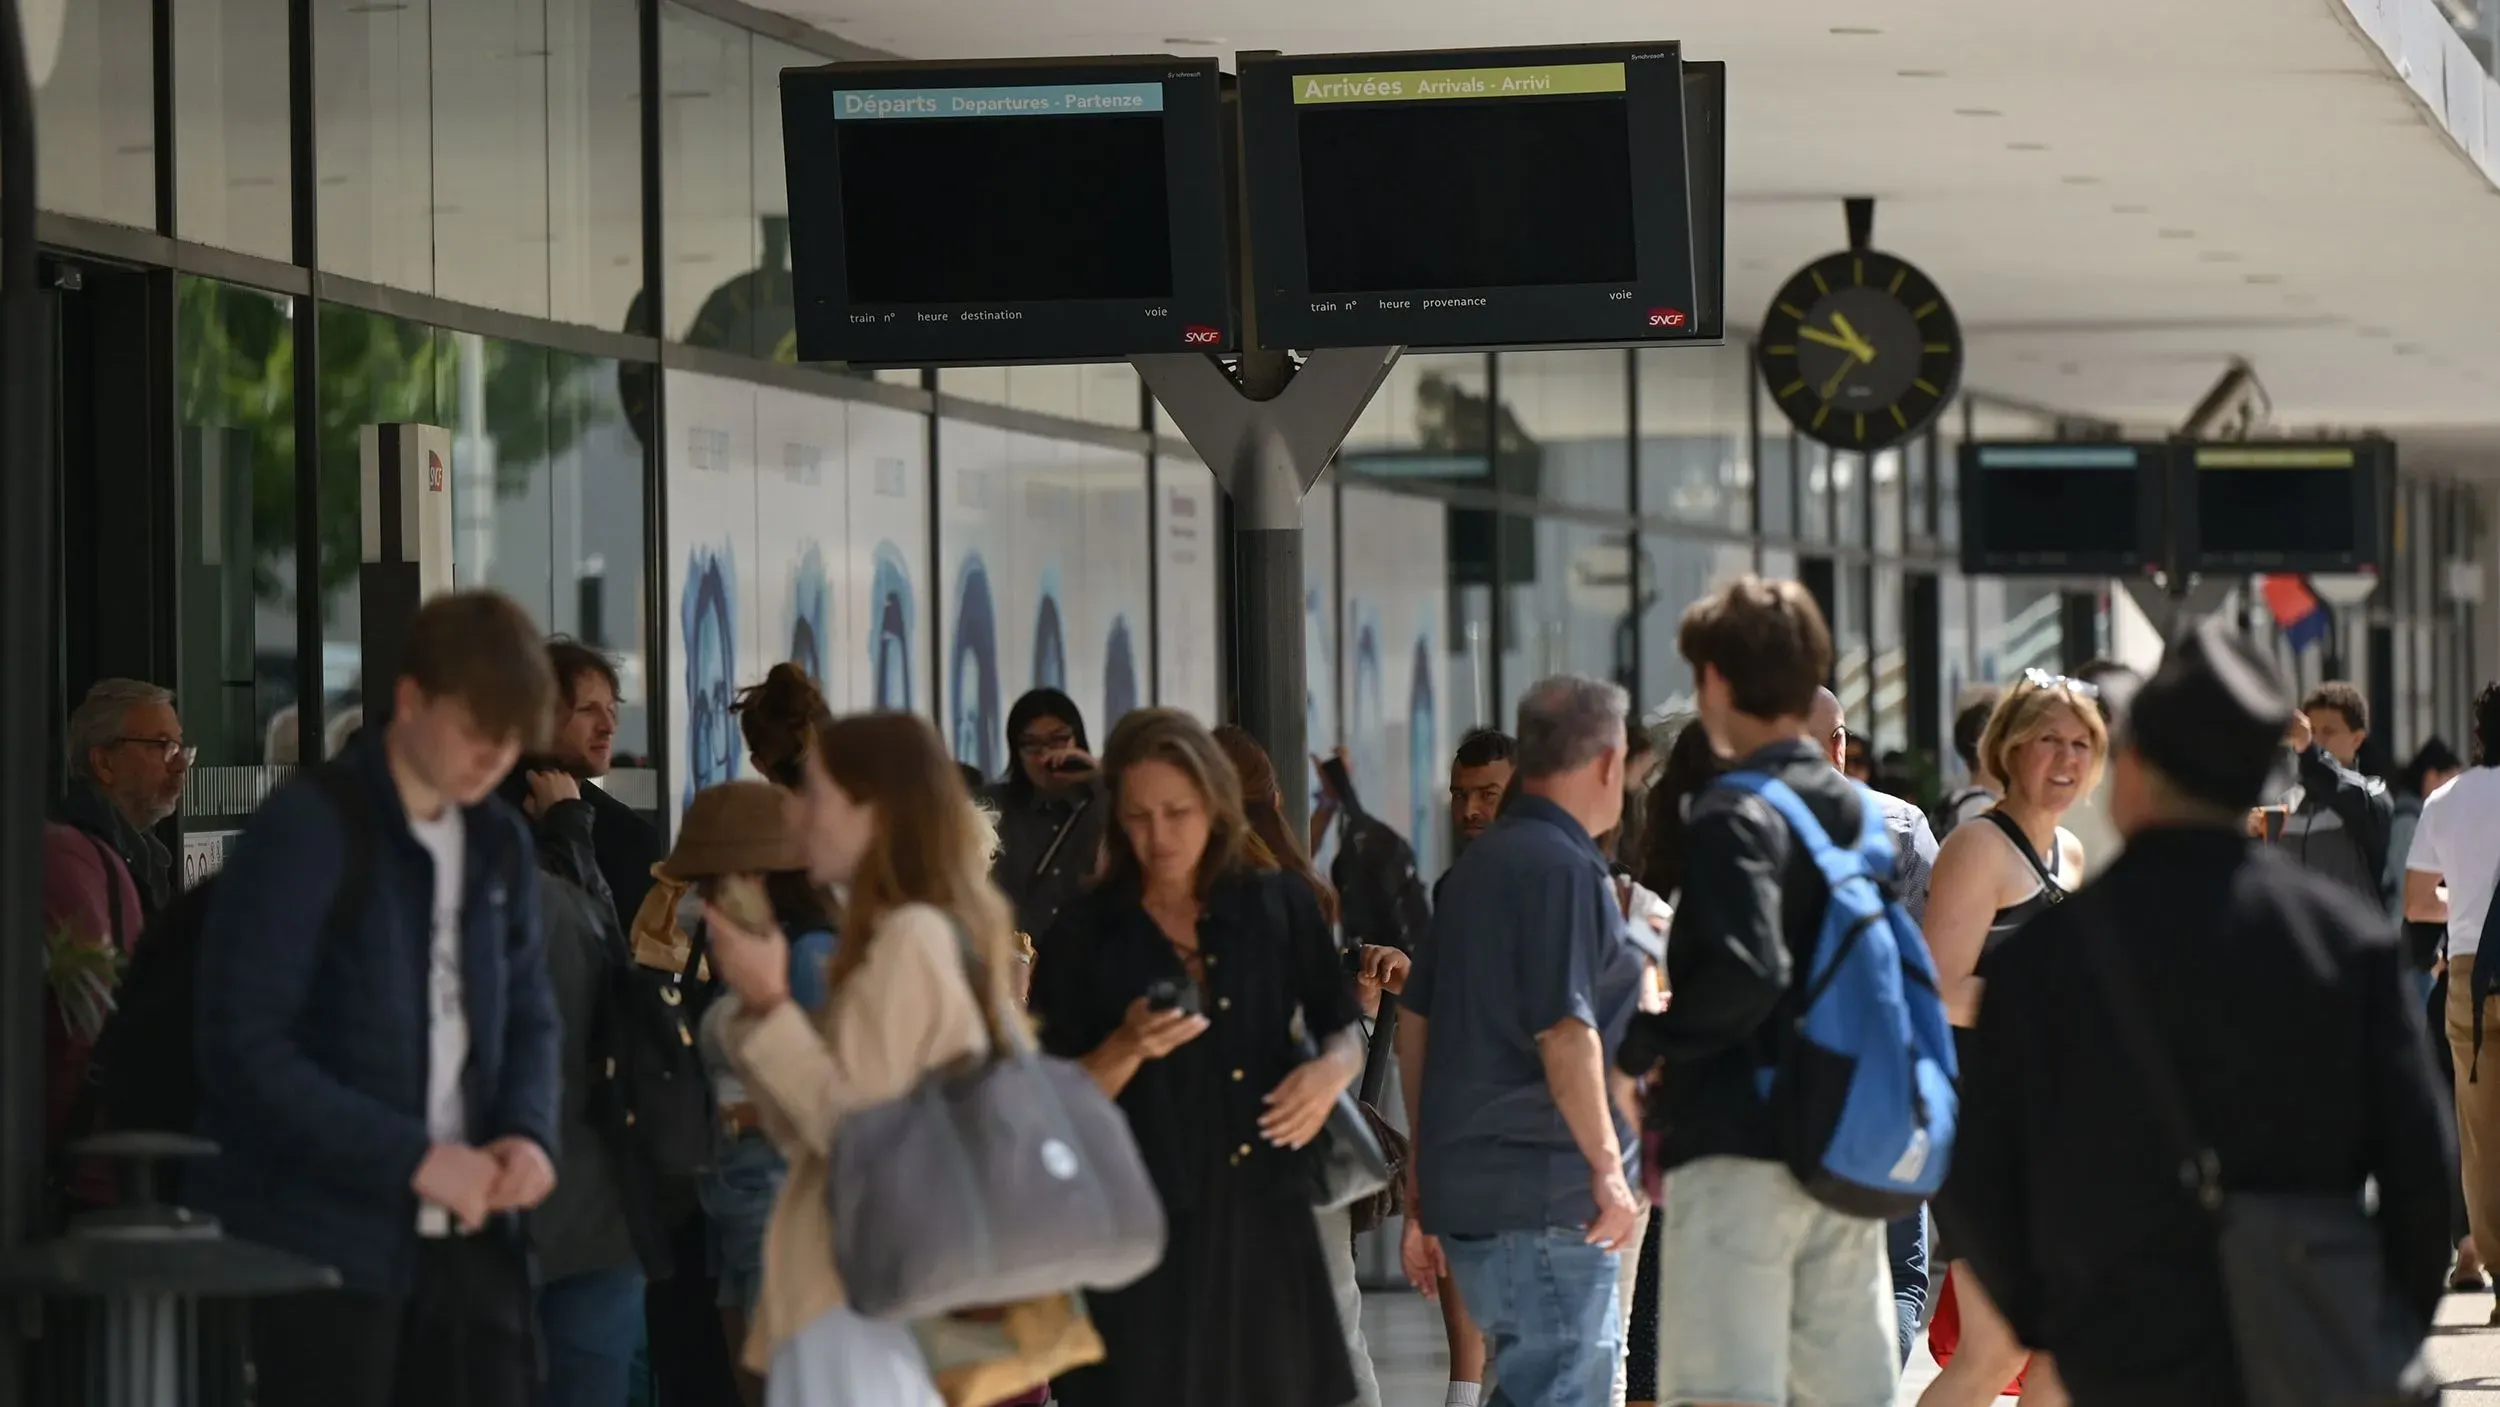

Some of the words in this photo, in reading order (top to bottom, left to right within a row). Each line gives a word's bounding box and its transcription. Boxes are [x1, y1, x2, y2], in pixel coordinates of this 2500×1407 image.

[1304, 77, 1402, 98] Arrivées
[1417, 77, 1485, 94] Arrivals
[1501, 75, 1550, 91] Arrivi
[845, 93, 937, 118] Départs
[952, 95, 1049, 115] Departures
[1065, 93, 1143, 108] Partenze
[1609, 290, 1633, 300] voie
[1310, 301, 1337, 312] train
[1379, 299, 1411, 309] heure
[1423, 297, 1487, 309] provenance
[850, 313, 876, 323] train
[917, 311, 949, 322] heure
[960, 310, 1023, 321] destination
[1144, 307, 1168, 318] voie
[1649, 314, 1684, 326] SNCF
[1185, 332, 1218, 343] SNCF
